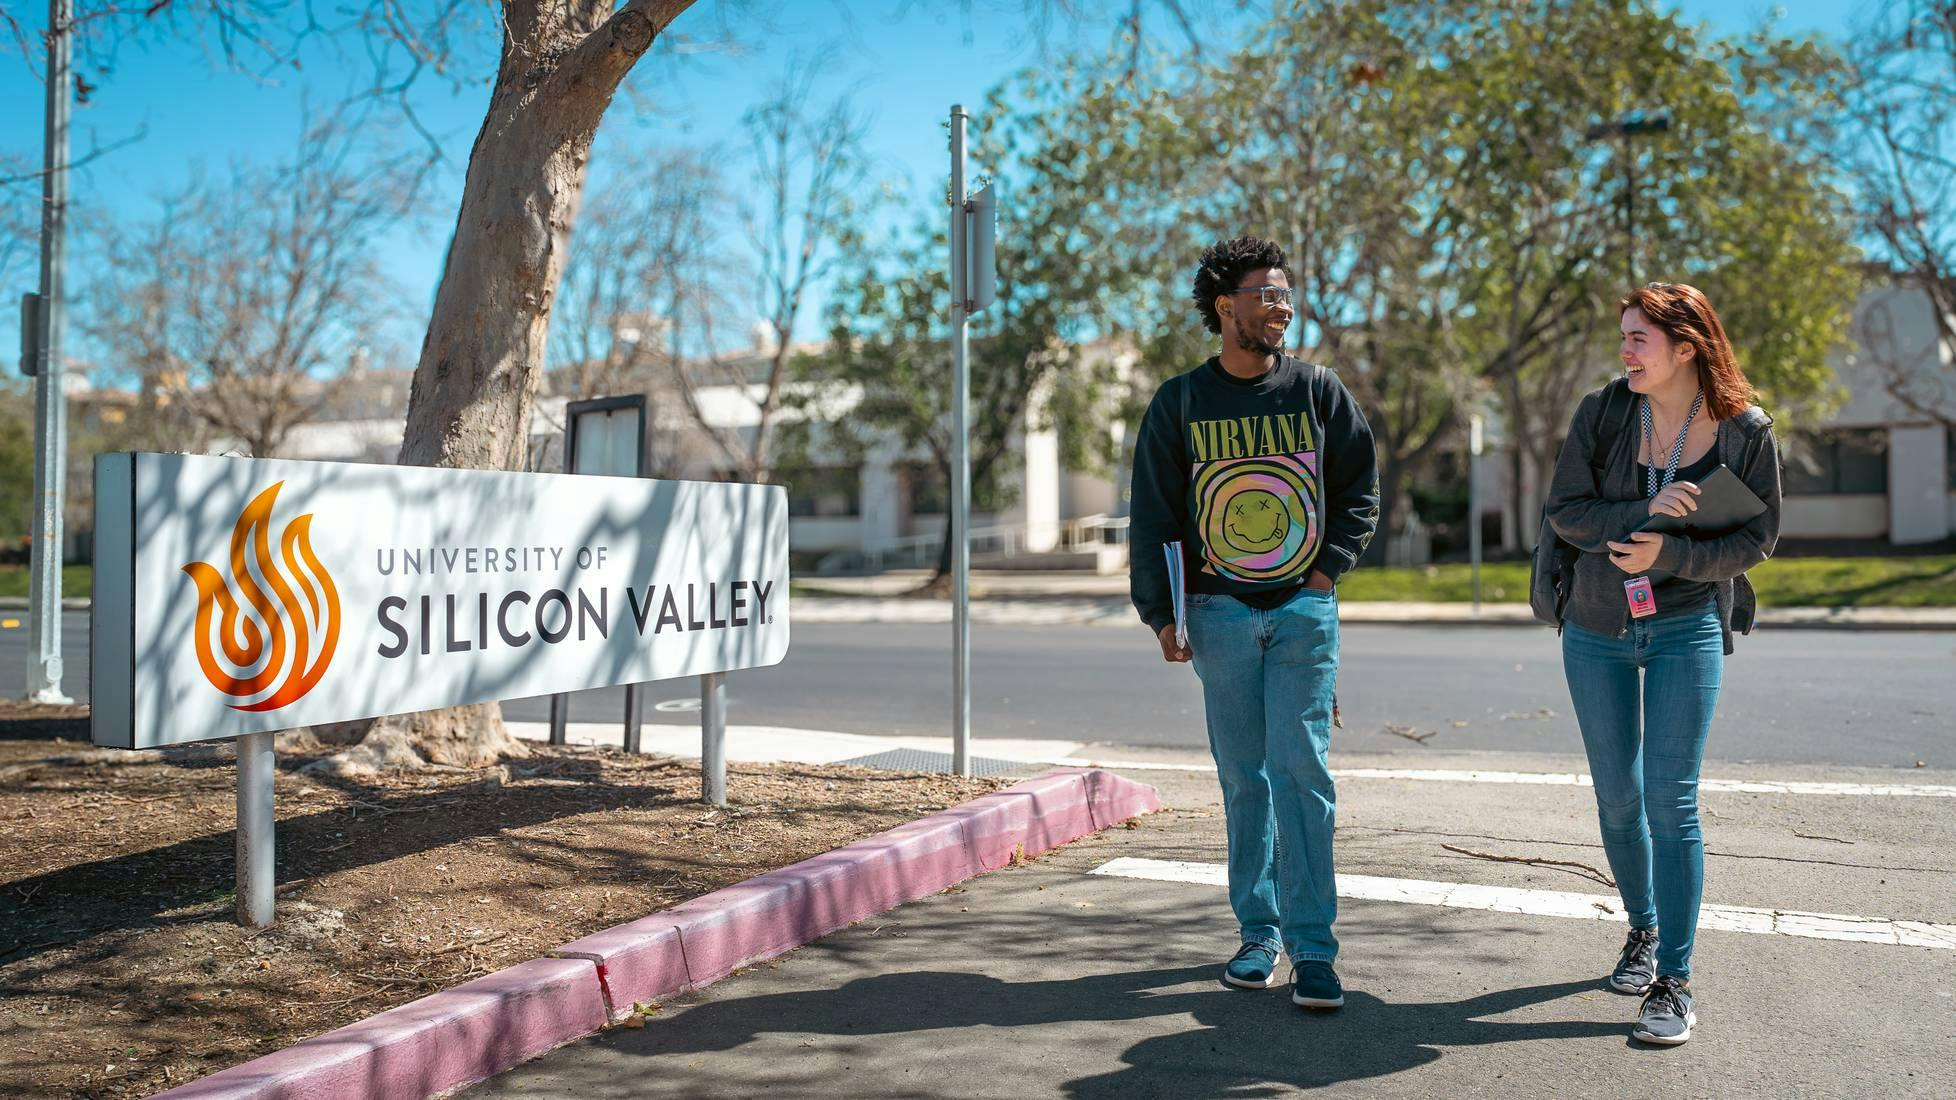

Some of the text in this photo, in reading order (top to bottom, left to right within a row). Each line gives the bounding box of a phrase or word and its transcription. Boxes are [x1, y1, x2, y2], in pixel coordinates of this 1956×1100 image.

[1189, 411, 1316, 462] NIRVANA
[377, 546, 608, 576] UNIVERSITY OF
[377, 587, 608, 659] SILICON
